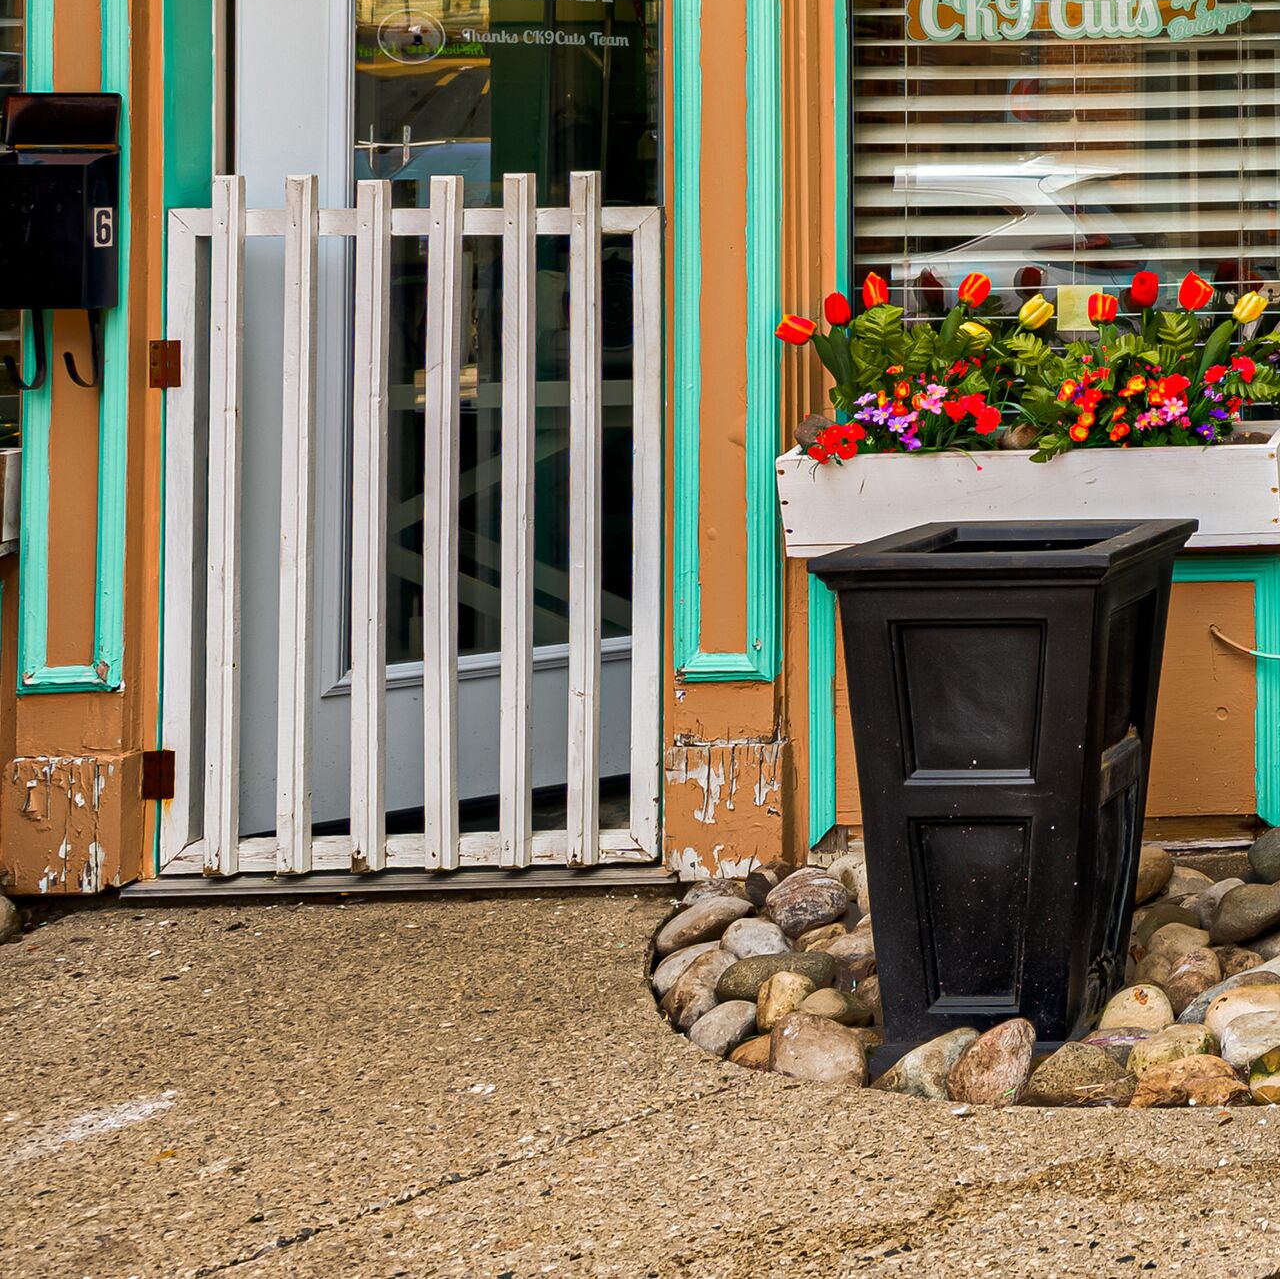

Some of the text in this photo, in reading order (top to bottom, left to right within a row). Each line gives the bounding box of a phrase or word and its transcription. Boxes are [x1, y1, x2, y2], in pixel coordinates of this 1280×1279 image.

[589, 31, 630, 47] Team
[1170, 5, 1250, 39] Boutique
[95, 209, 112, 245] 6
